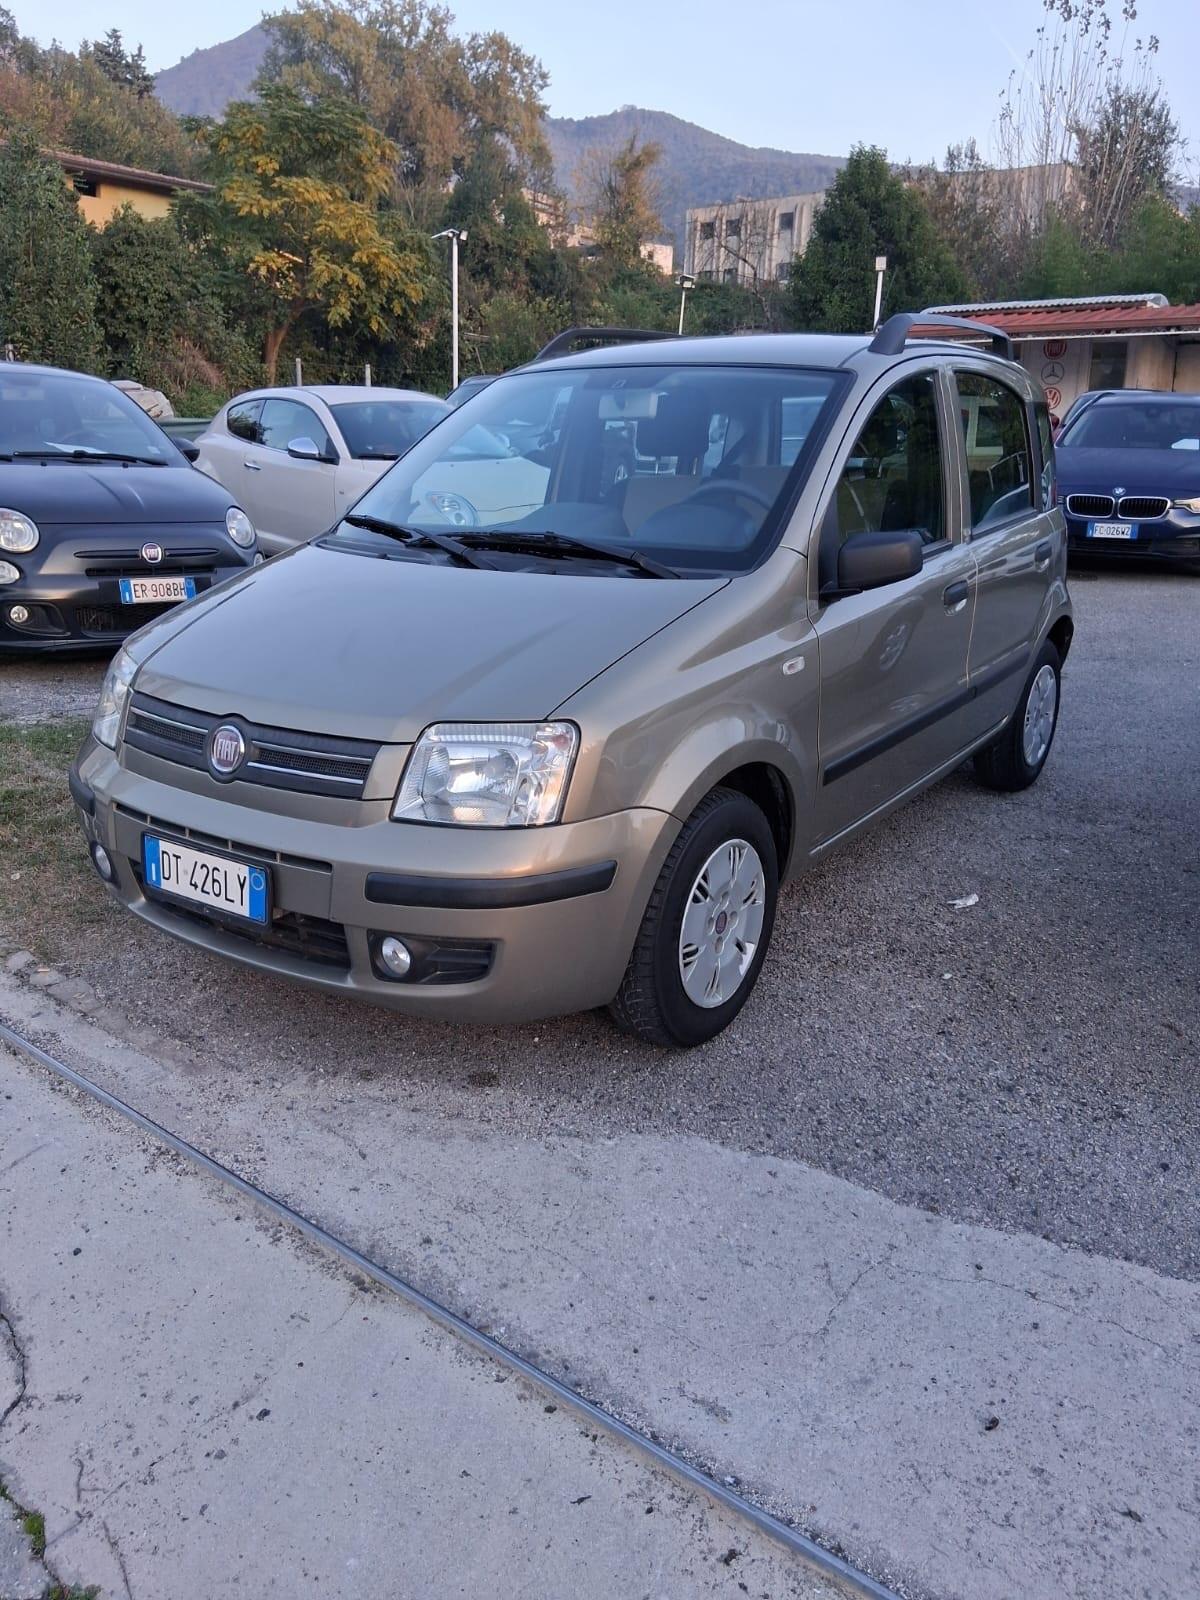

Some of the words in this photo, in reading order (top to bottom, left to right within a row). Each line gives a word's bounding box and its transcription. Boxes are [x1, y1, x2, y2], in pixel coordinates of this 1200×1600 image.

[133, 583, 148, 598] ER
[151, 582, 186, 598] 908BH
[217, 738, 238, 762] FIAT
[161, 850, 181, 885] DT
[189, 860, 247, 907] 426LY
